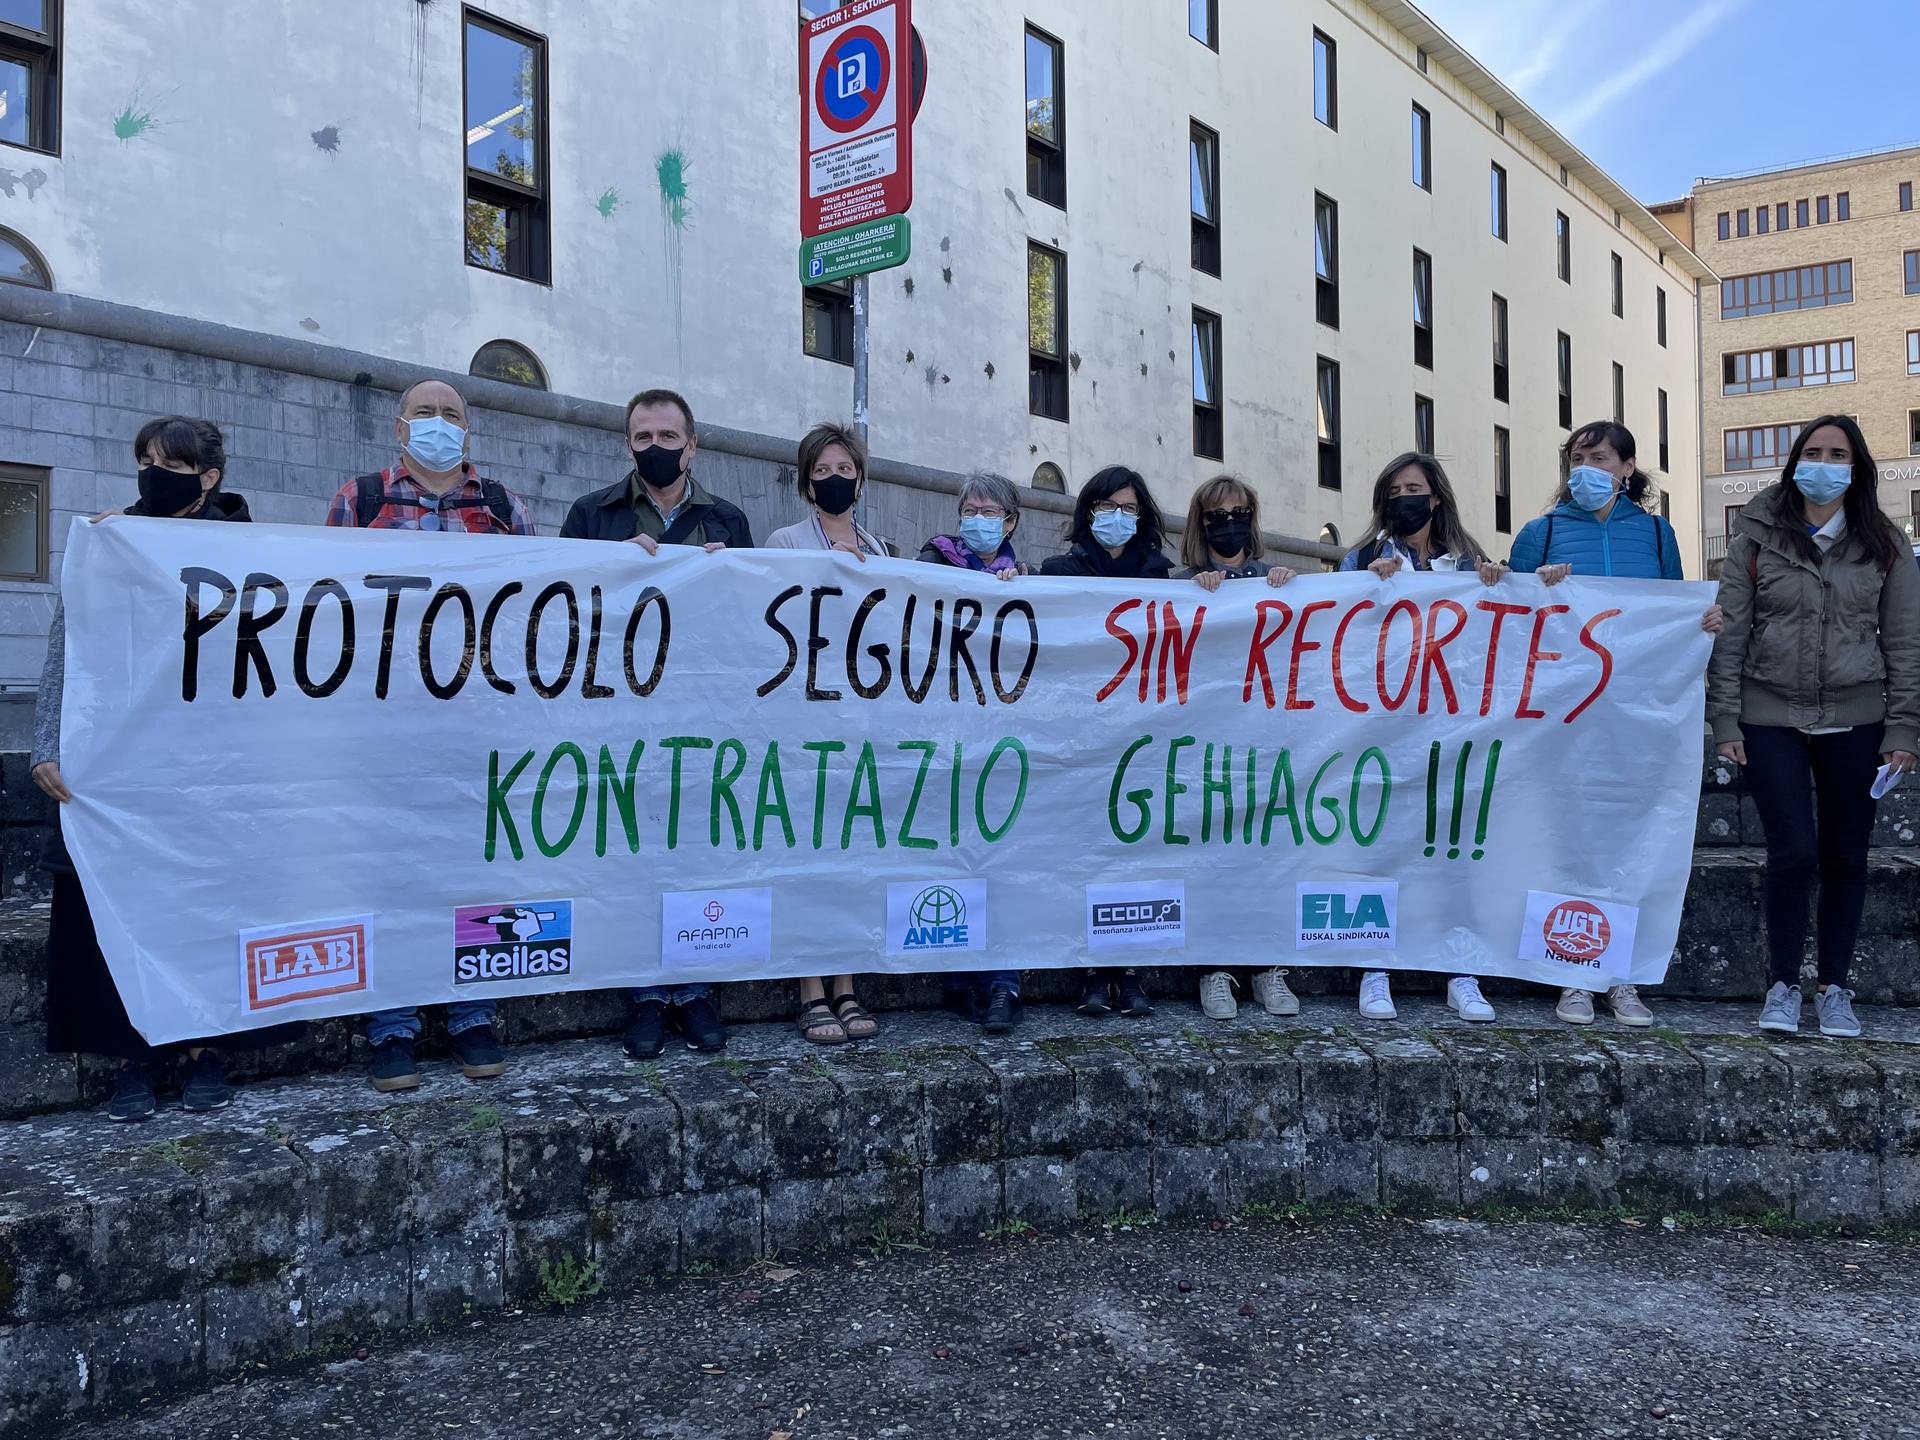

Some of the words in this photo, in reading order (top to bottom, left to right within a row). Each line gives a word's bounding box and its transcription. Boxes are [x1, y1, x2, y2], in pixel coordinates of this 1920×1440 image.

[811, 12, 841, 32] SECTOR
[844, 10, 850, 20] 1.
[817, 183, 832, 193] TIEMPO
[834, 178, 850, 188] MÁXIMO
[823, 195, 841, 204] TIQUE
[842, 183, 882, 199] OBLIGATORIO
[820, 201, 846, 213] INCLUSO
[848, 190, 885, 205] RESIDENTES
[820, 212, 841, 222] TIKETA
[842, 200, 885, 216] NAHITAEZKOA
[818, 210, 873, 230] BIZILAGUNENTZAT
[874, 206, 887, 215] ERE
[825, 261, 859, 273] BIZILAGUNAK
[860, 254, 886, 264] BESTERIK
[836, 254, 849, 262] SOLO
[850, 246, 882, 258] RESIDENTES
[179, 566, 671, 701] PROTOCOLO
[756, 584, 1039, 706] SEGURO
[1096, 597, 1208, 705] SIN
[1242, 598, 1623, 724] RECORTES
[484, 735, 1029, 862] KONTRATAZIO
[1107, 734, 1392, 847] GEHIAGO
[1423, 738, 1502, 861] !!!
[1098, 905, 1152, 922] CCOO
[1302, 893, 1390, 929] ELA
[1093, 927, 1132, 935] enseñanza
[1134, 923, 1180, 932] irakaskuntza
[1551, 908, 1603, 938] UGT
[678, 926, 748, 942] AFAPNA
[903, 925, 968, 945] ANPE
[1337, 932, 1390, 940] SINDIKATUA
[260, 940, 352, 982] LAB
[457, 945, 568, 980] steilas
[1545, 949, 1600, 968] Navarra
